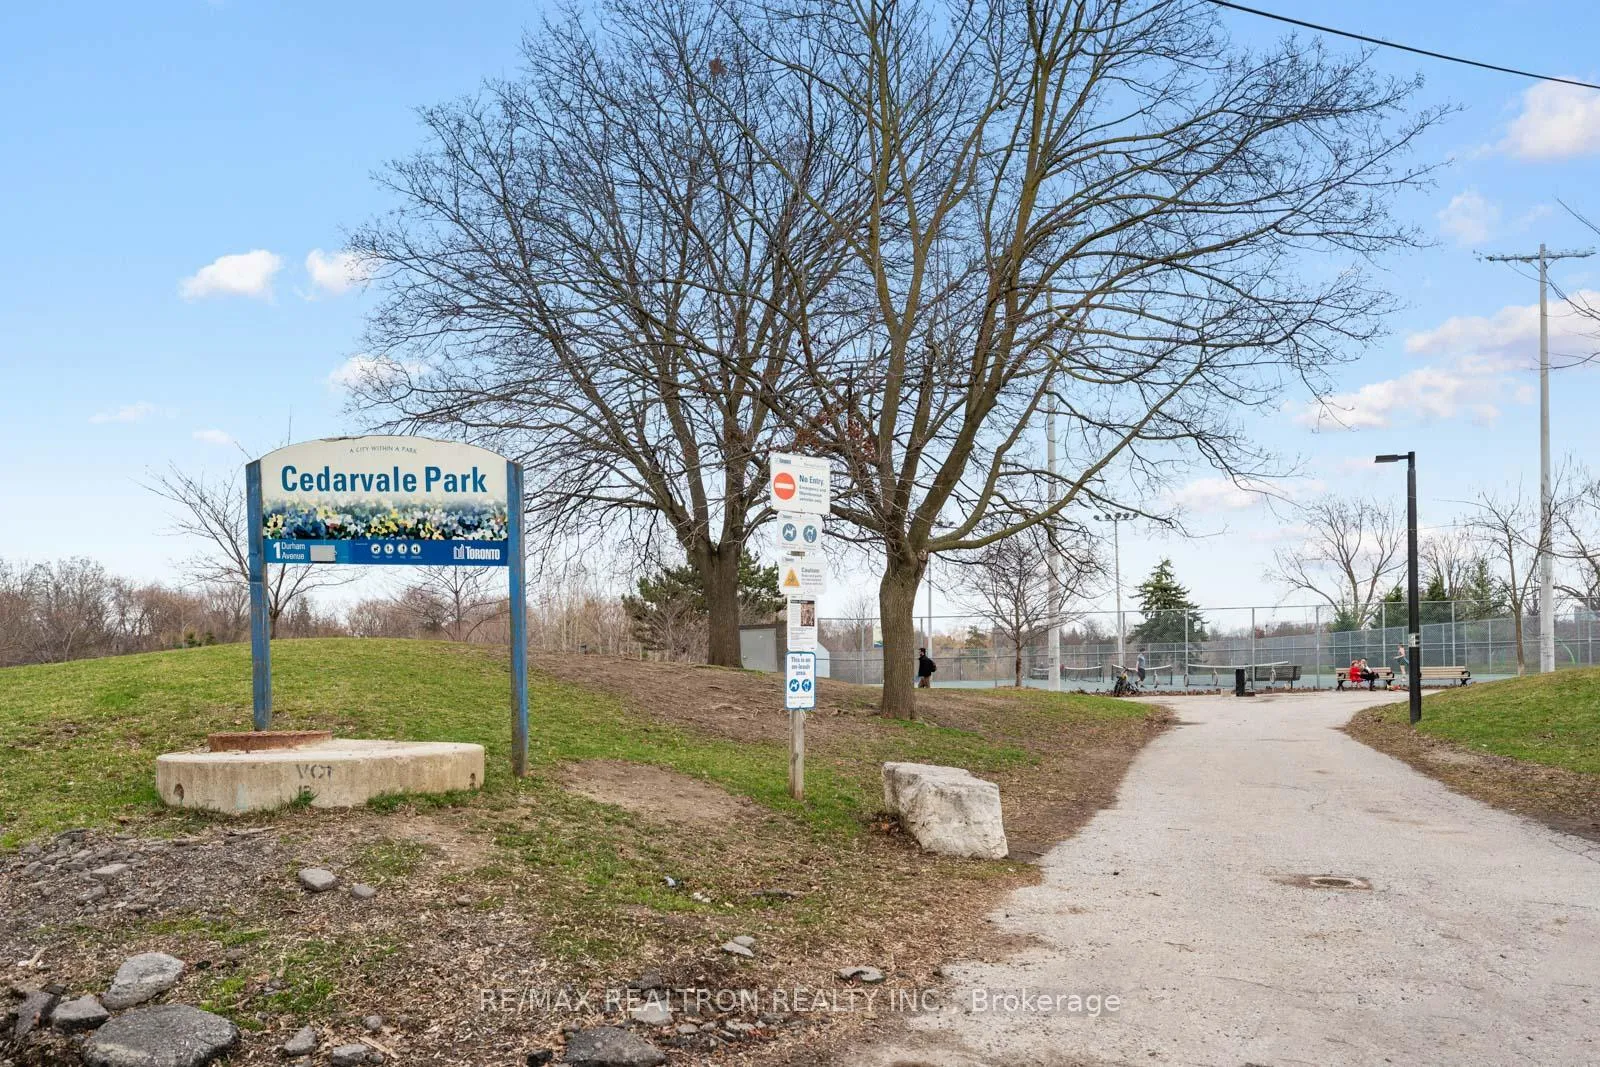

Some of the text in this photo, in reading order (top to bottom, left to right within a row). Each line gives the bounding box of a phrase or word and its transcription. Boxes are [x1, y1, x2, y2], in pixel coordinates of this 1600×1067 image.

[372, 445, 392, 453] WITHIN
[281, 465, 487, 493] Cedarvale Park
[799, 474, 808, 483] No
[273, 541, 281, 559] 1
[281, 541, 306, 551] Durham
[281, 552, 305, 560] Avenue
[465, 546, 501, 560] TORONTO
[791, 655, 801, 663] This
